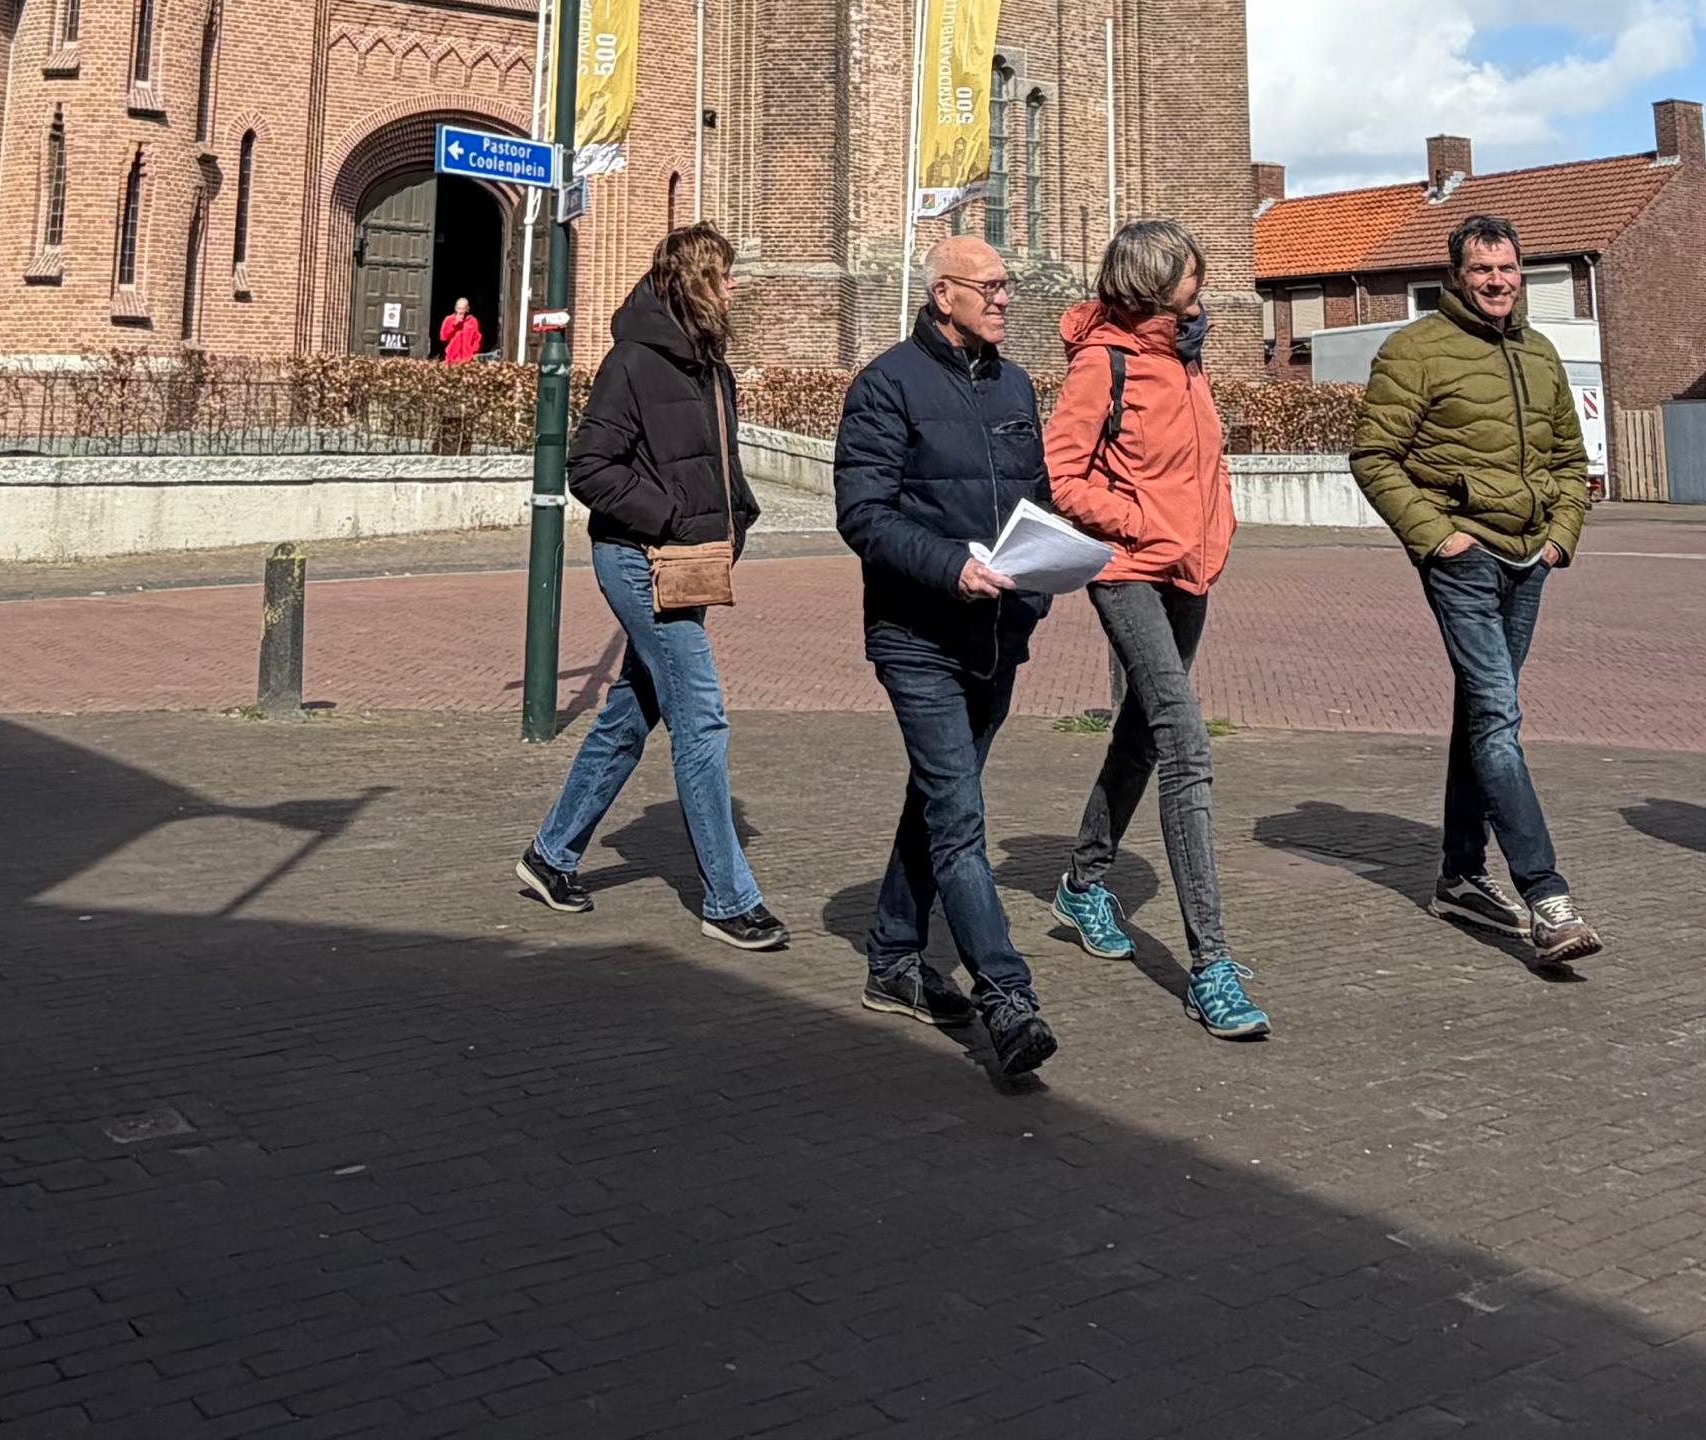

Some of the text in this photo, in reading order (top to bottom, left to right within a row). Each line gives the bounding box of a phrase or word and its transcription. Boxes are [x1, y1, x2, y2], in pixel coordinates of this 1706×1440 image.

[594, 32, 617, 76] 500
[956, 86, 974, 124] 500
[483, 137, 532, 159] Pastoor
[468, 151, 545, 178] Coolenplein
